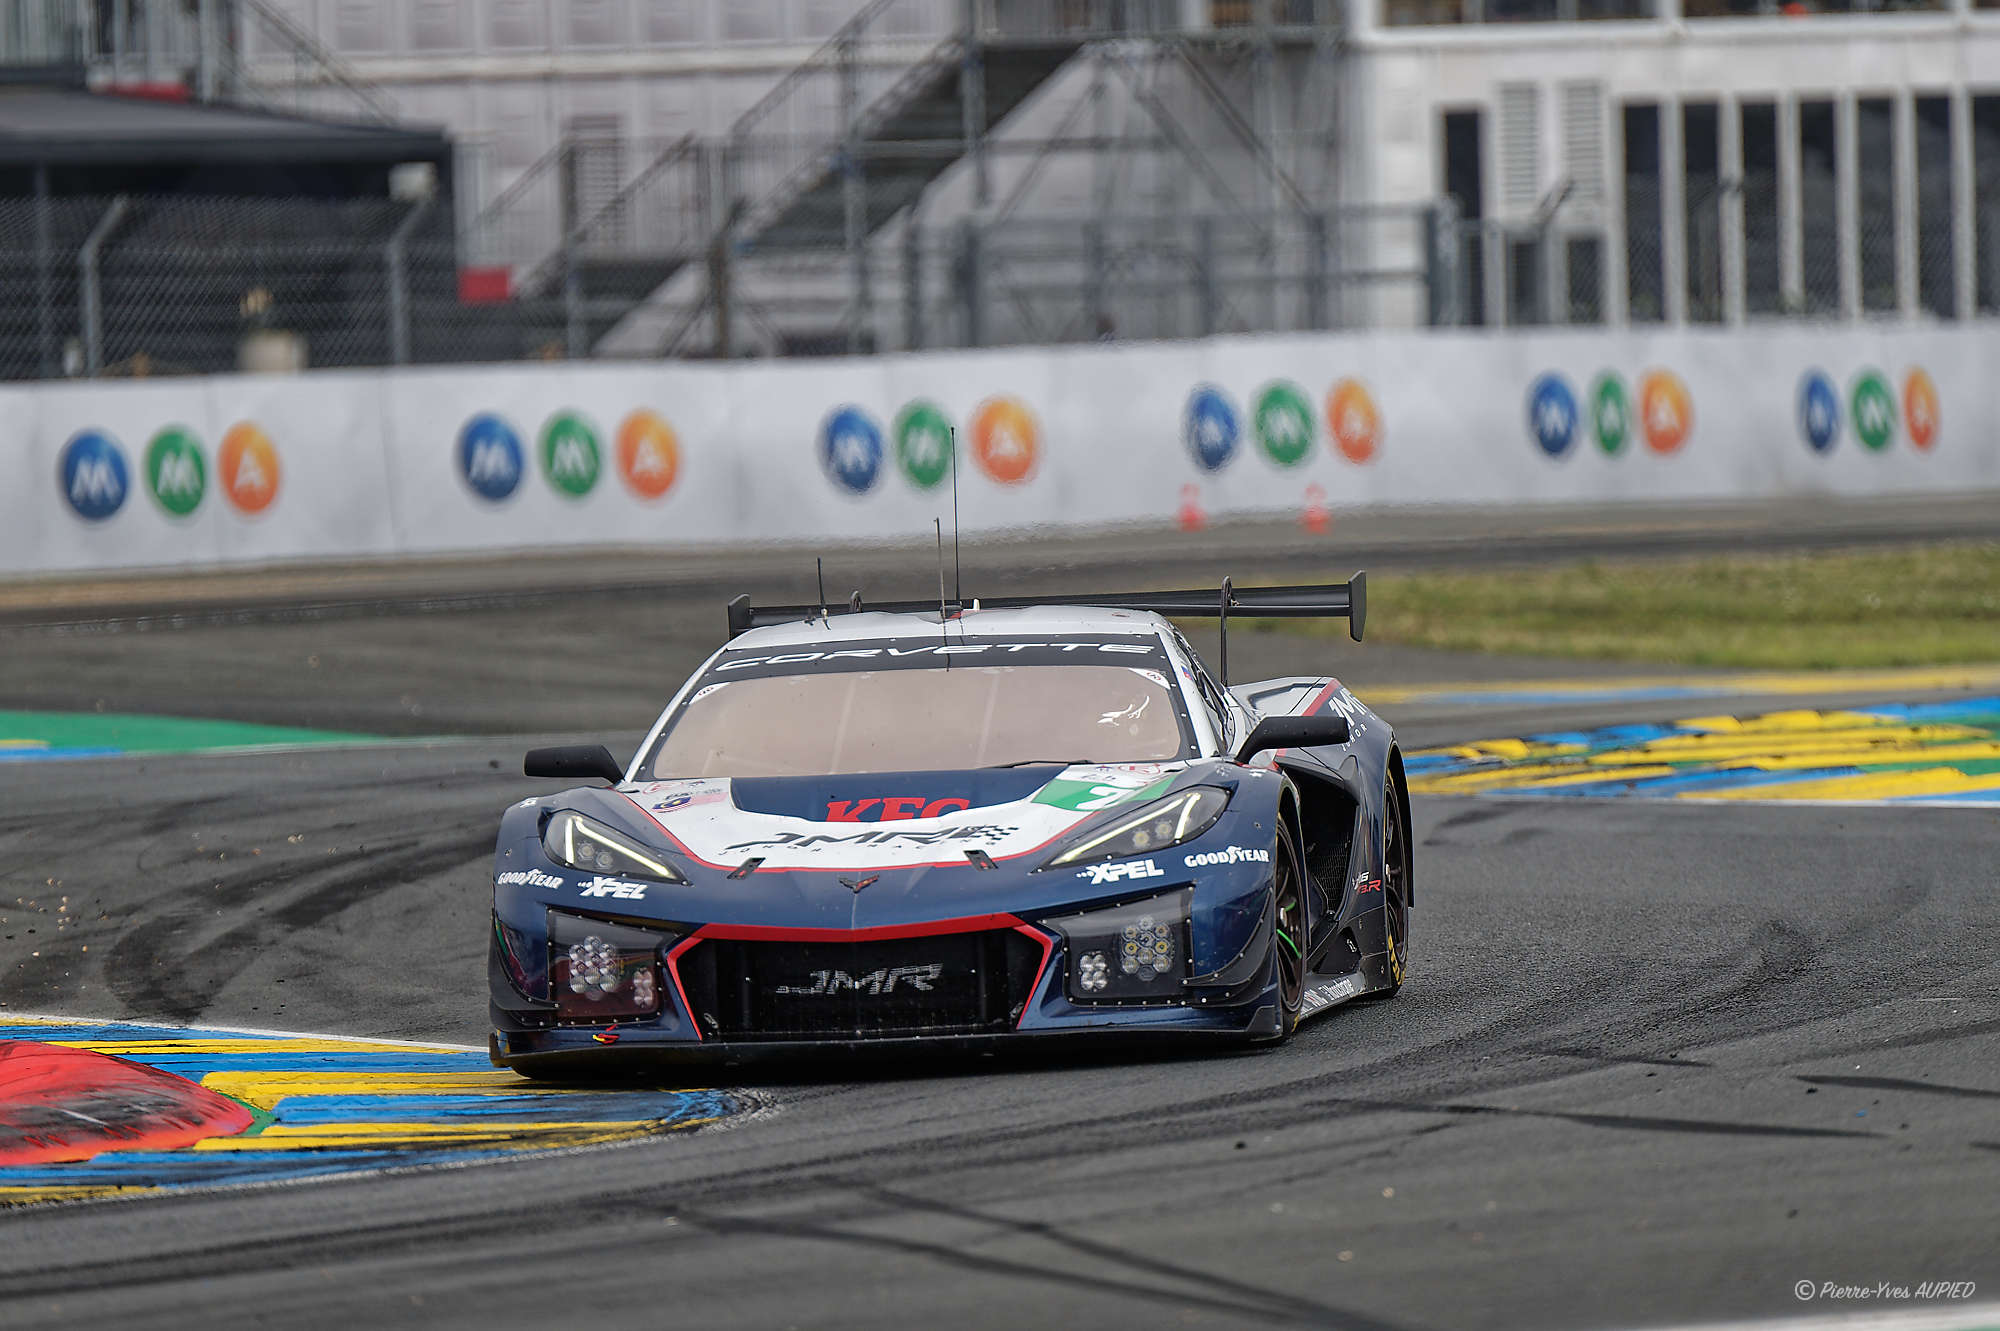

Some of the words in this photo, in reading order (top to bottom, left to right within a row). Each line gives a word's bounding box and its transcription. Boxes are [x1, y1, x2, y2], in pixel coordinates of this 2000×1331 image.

[715, 643, 1155, 671] CORVETTE
[1184, 846, 1270, 867] GOODYEAR
[498, 868, 564, 889] GOODYEAR
[1083, 859, 1165, 885] XPEL
[579, 876, 648, 899] XPEL
[776, 963, 943, 994] JMR
